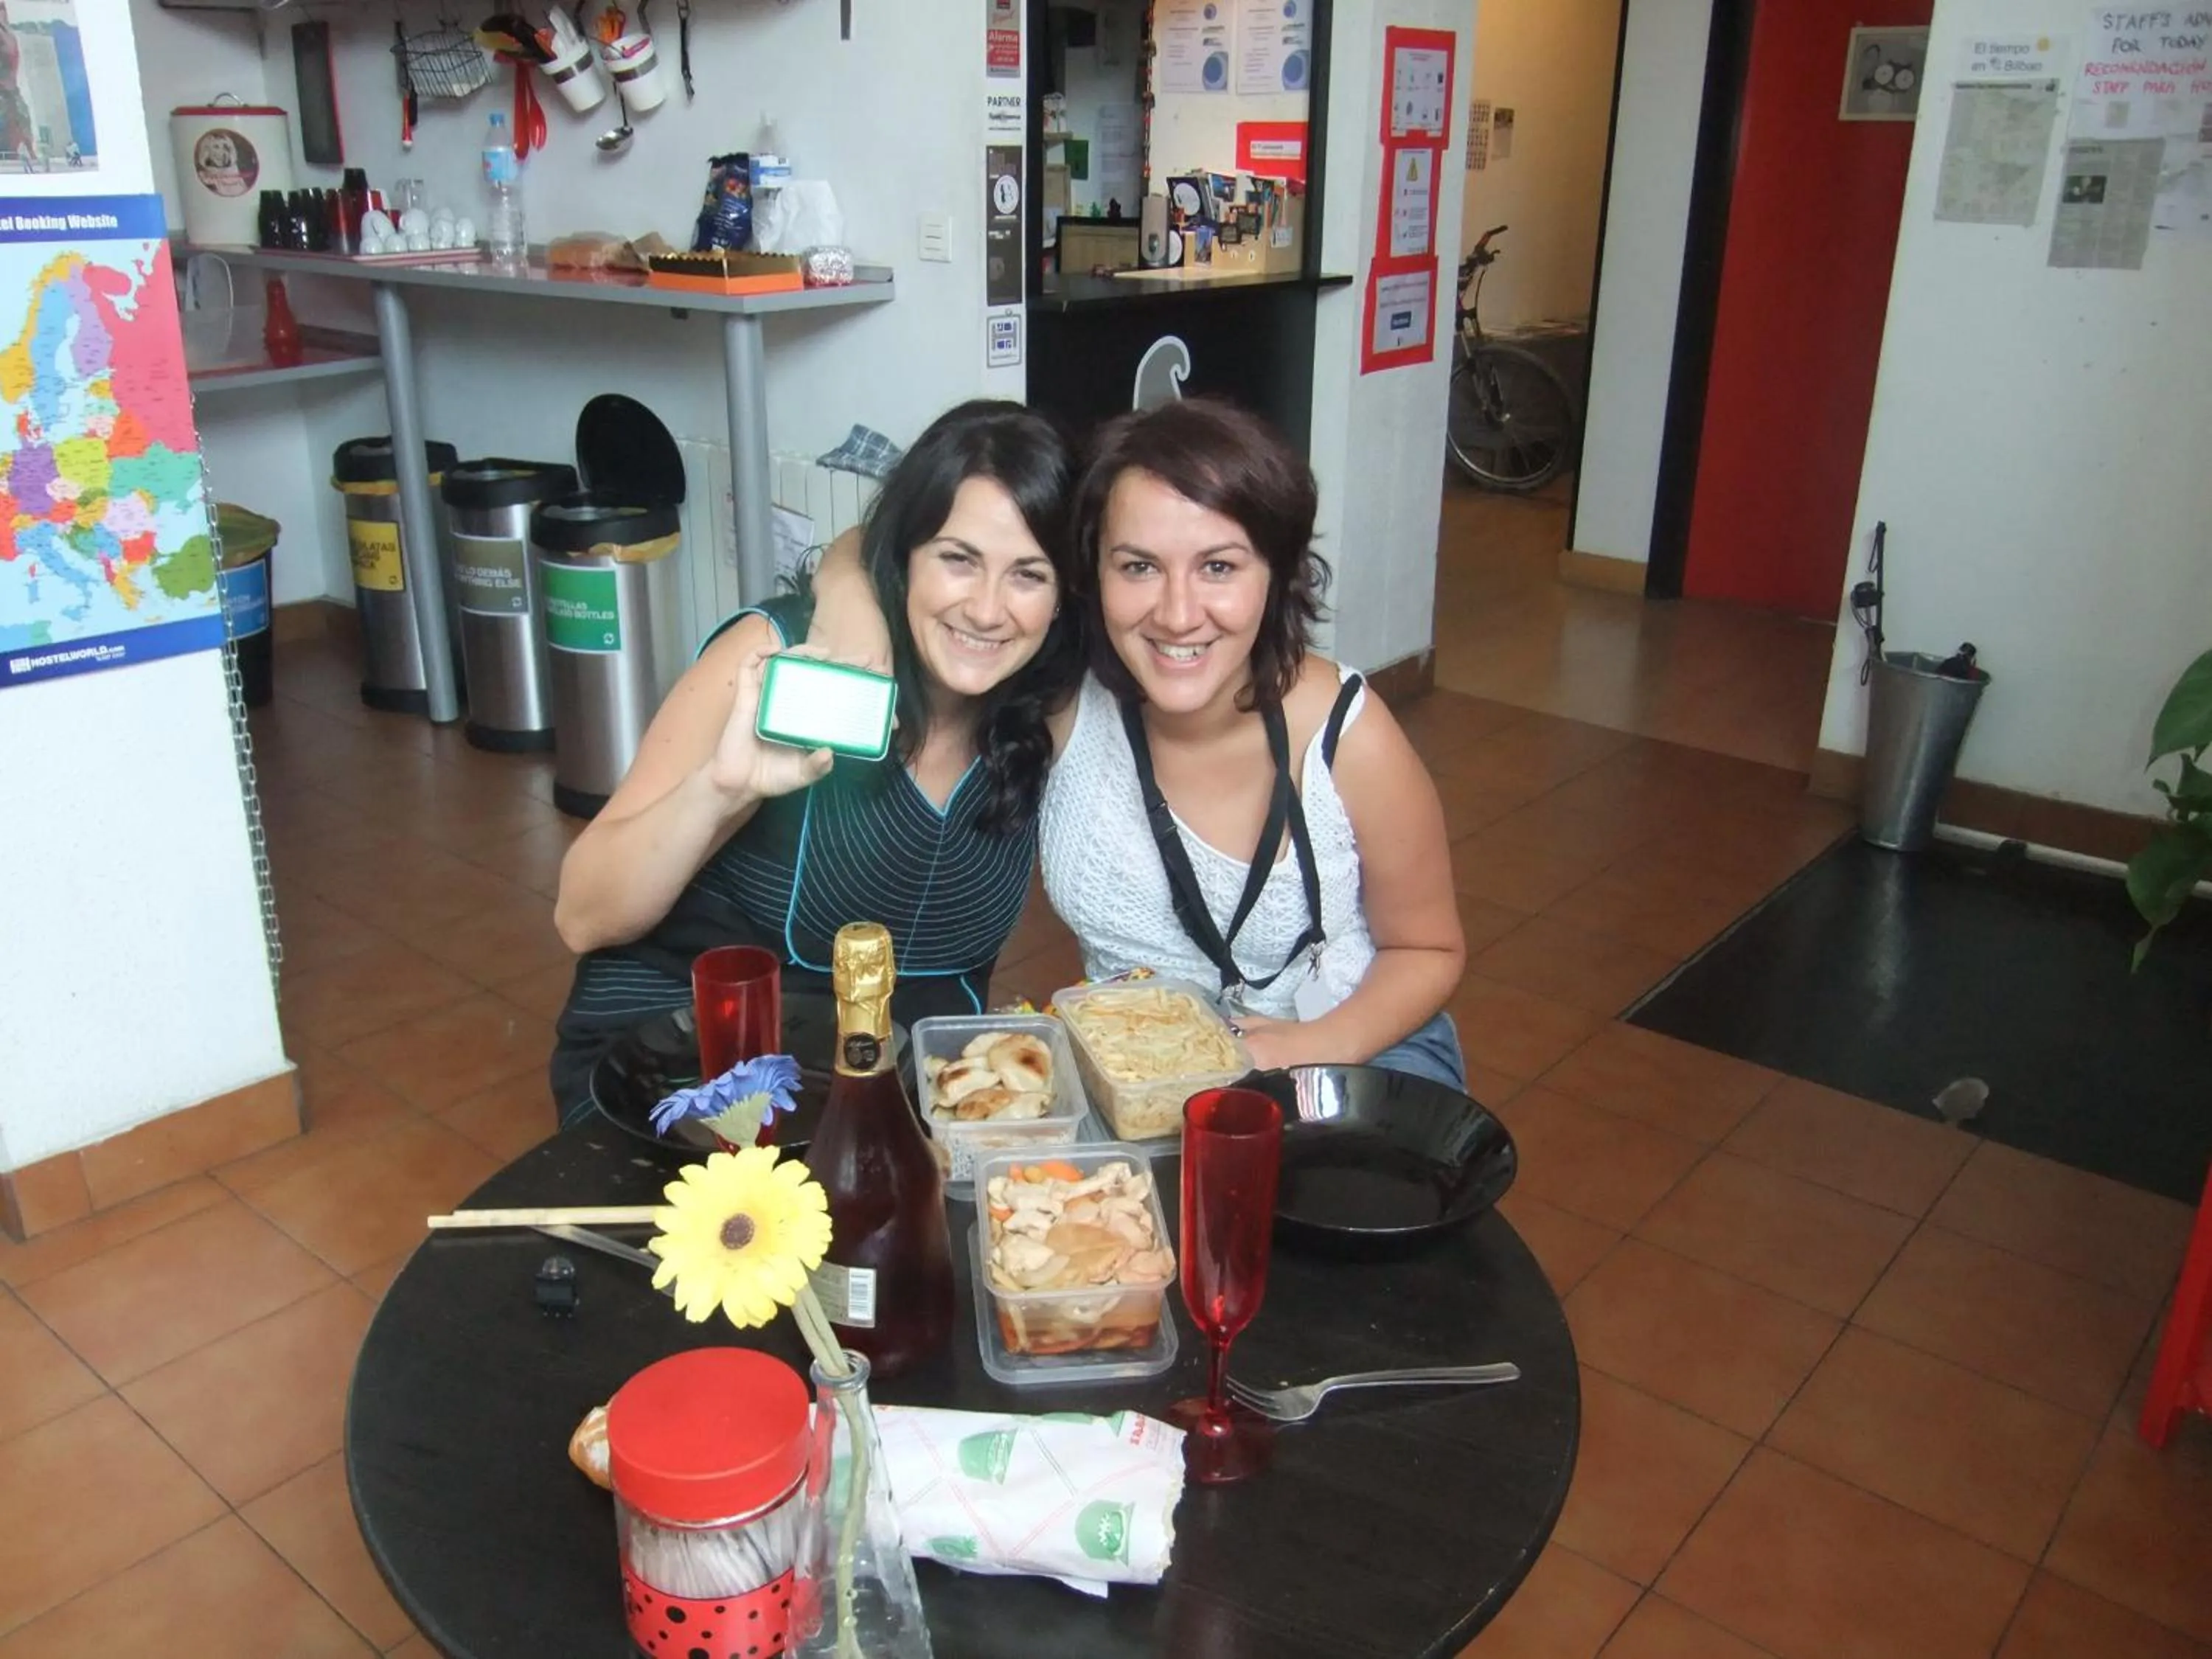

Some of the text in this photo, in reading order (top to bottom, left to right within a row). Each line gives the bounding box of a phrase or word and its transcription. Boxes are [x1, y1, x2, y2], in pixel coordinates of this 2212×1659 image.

[1974, 42, 2030, 55] El tiempo
[2112, 35, 2205, 54] FOR TODAY
[987, 96, 1021, 107] PARTNER
[15, 215, 66, 231] Booking
[67, 214, 118, 229] Website
